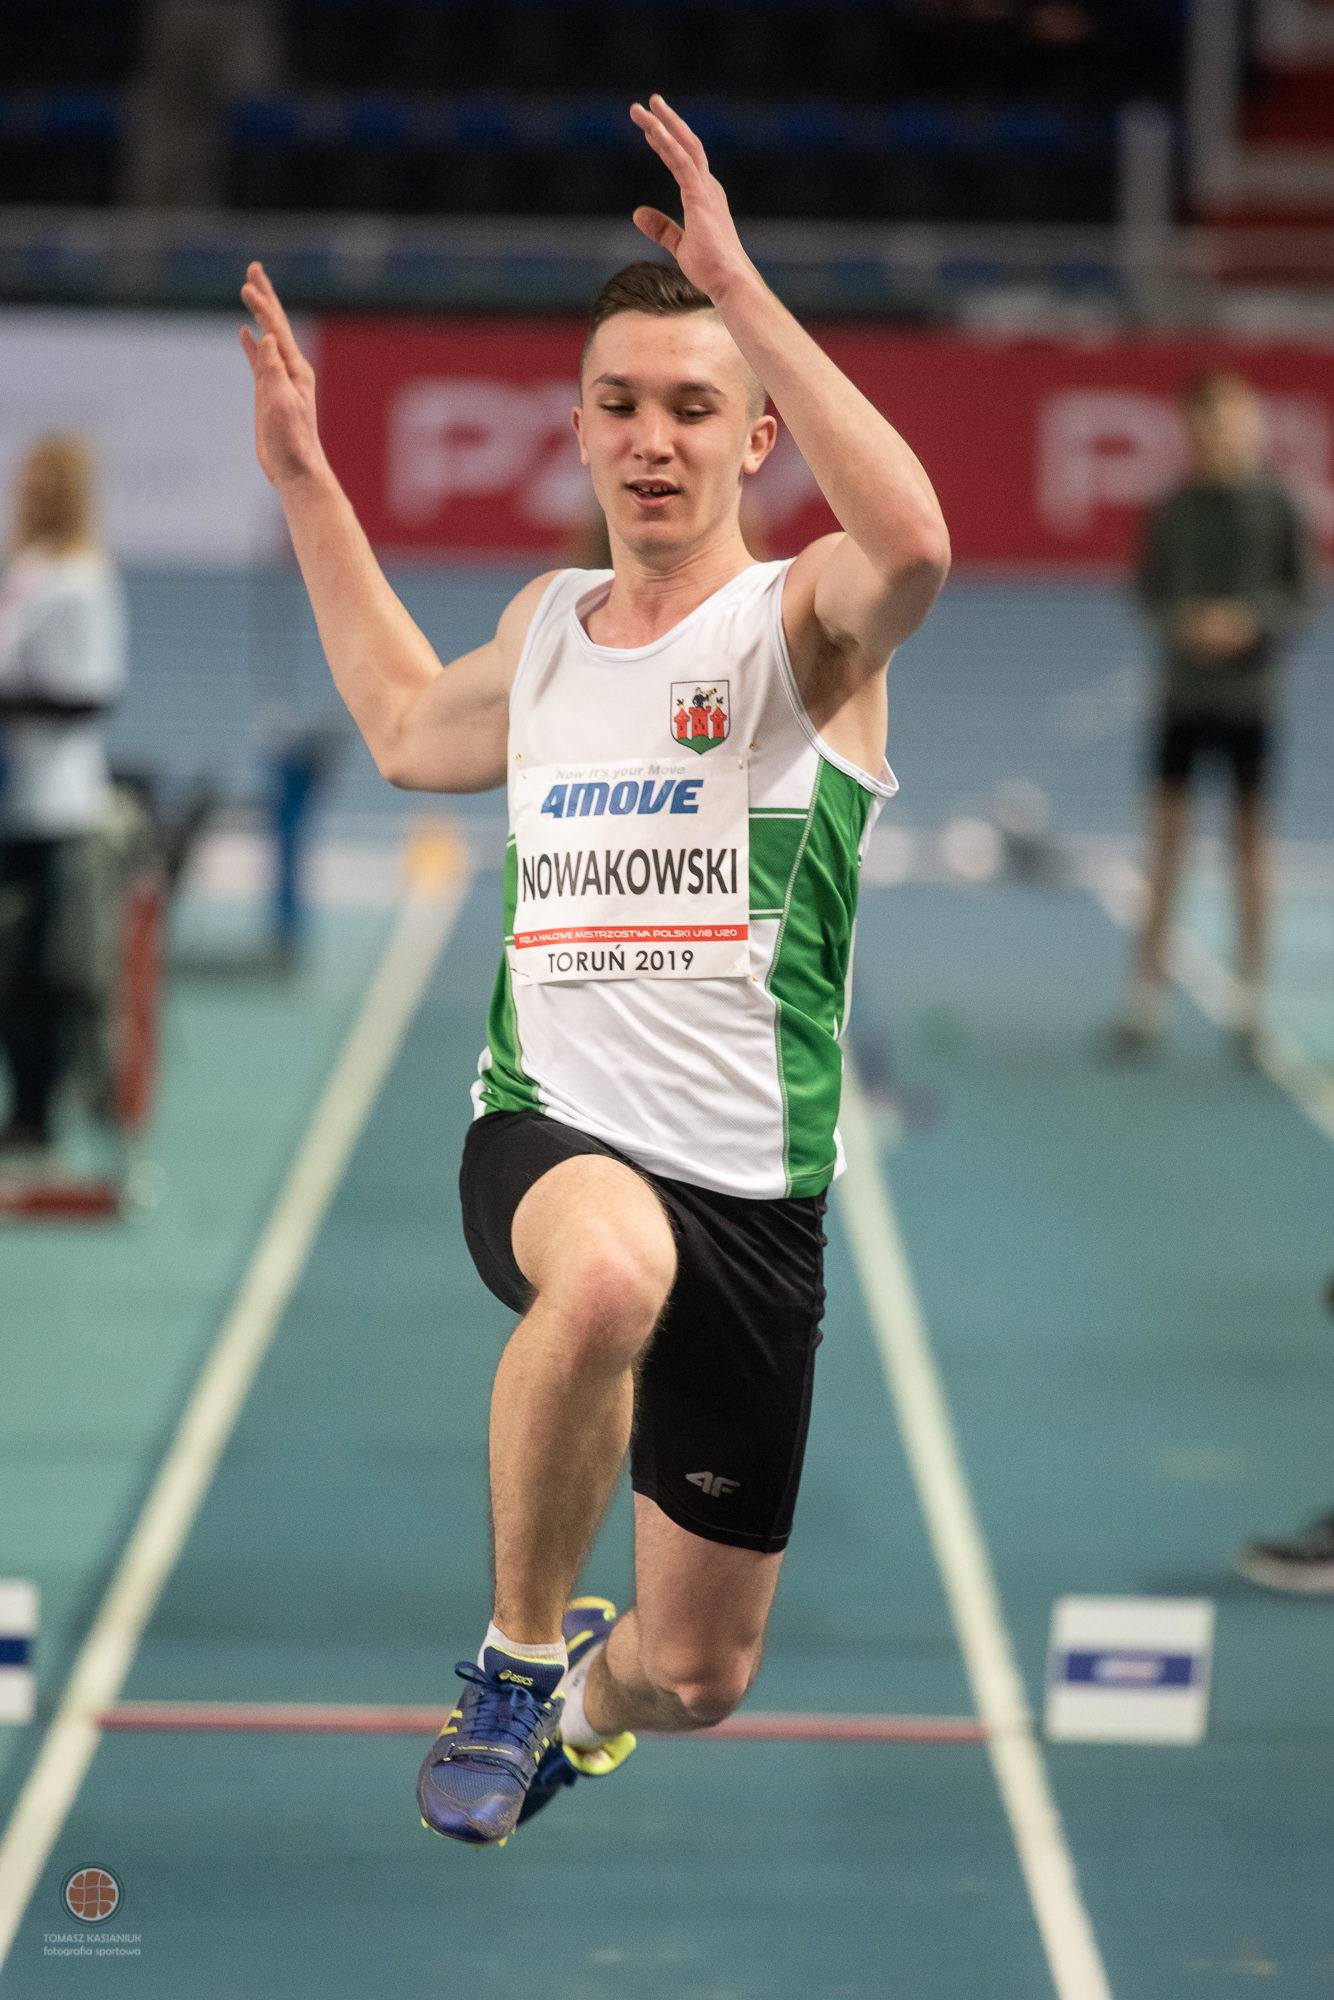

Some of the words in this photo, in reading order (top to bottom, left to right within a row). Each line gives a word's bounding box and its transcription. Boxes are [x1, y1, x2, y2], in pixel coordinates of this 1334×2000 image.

[612, 767, 645, 780] your
[647, 764, 686, 776] Move
[540, 779, 704, 819] 4MOVE
[522, 847, 738, 902] NOWAKOWSKI
[574, 930, 651, 939] MISTRZOSTWA
[652, 930, 691, 938] POLSKI
[692, 929, 713, 938] U18
[714, 929, 738, 937] U20
[547, 944, 625, 973] TORUŃ
[635, 949, 694, 971] 2019
[684, 1471, 741, 1498] 4F
